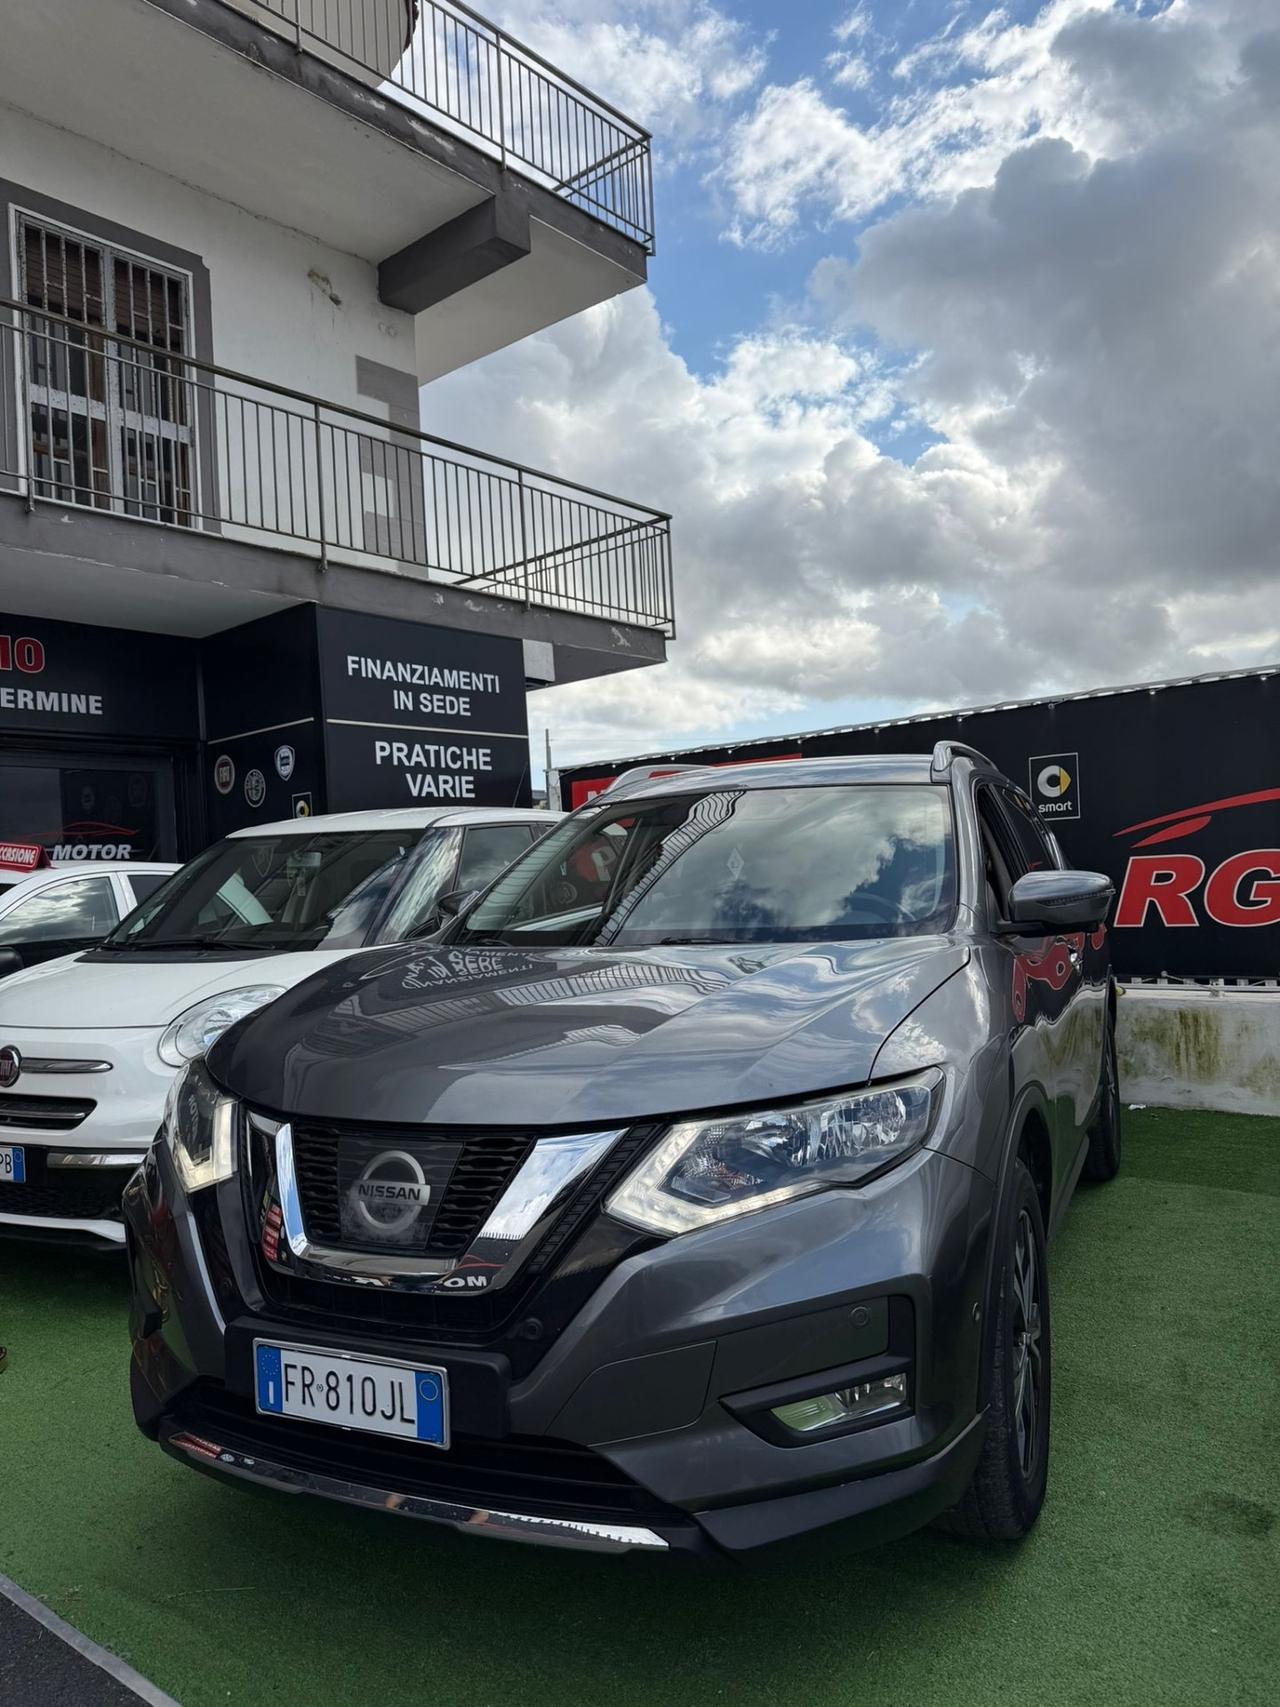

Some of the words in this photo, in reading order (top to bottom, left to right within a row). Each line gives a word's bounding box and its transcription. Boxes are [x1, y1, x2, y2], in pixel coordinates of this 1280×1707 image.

[346, 655, 501, 694] FINANZIAMENTI
[0, 687, 103, 715] ERMINE
[392, 689, 414, 711] IN
[419, 692, 472, 717] SEDE
[374, 740, 493, 771] PRATICHE
[405, 773, 476, 798] VARIE
[1038, 800, 1073, 813] smart
[52, 843, 132, 860] MOTOR
[1112, 848, 1280, 928] RG
[358, 1183, 421, 1201] NISSAN
